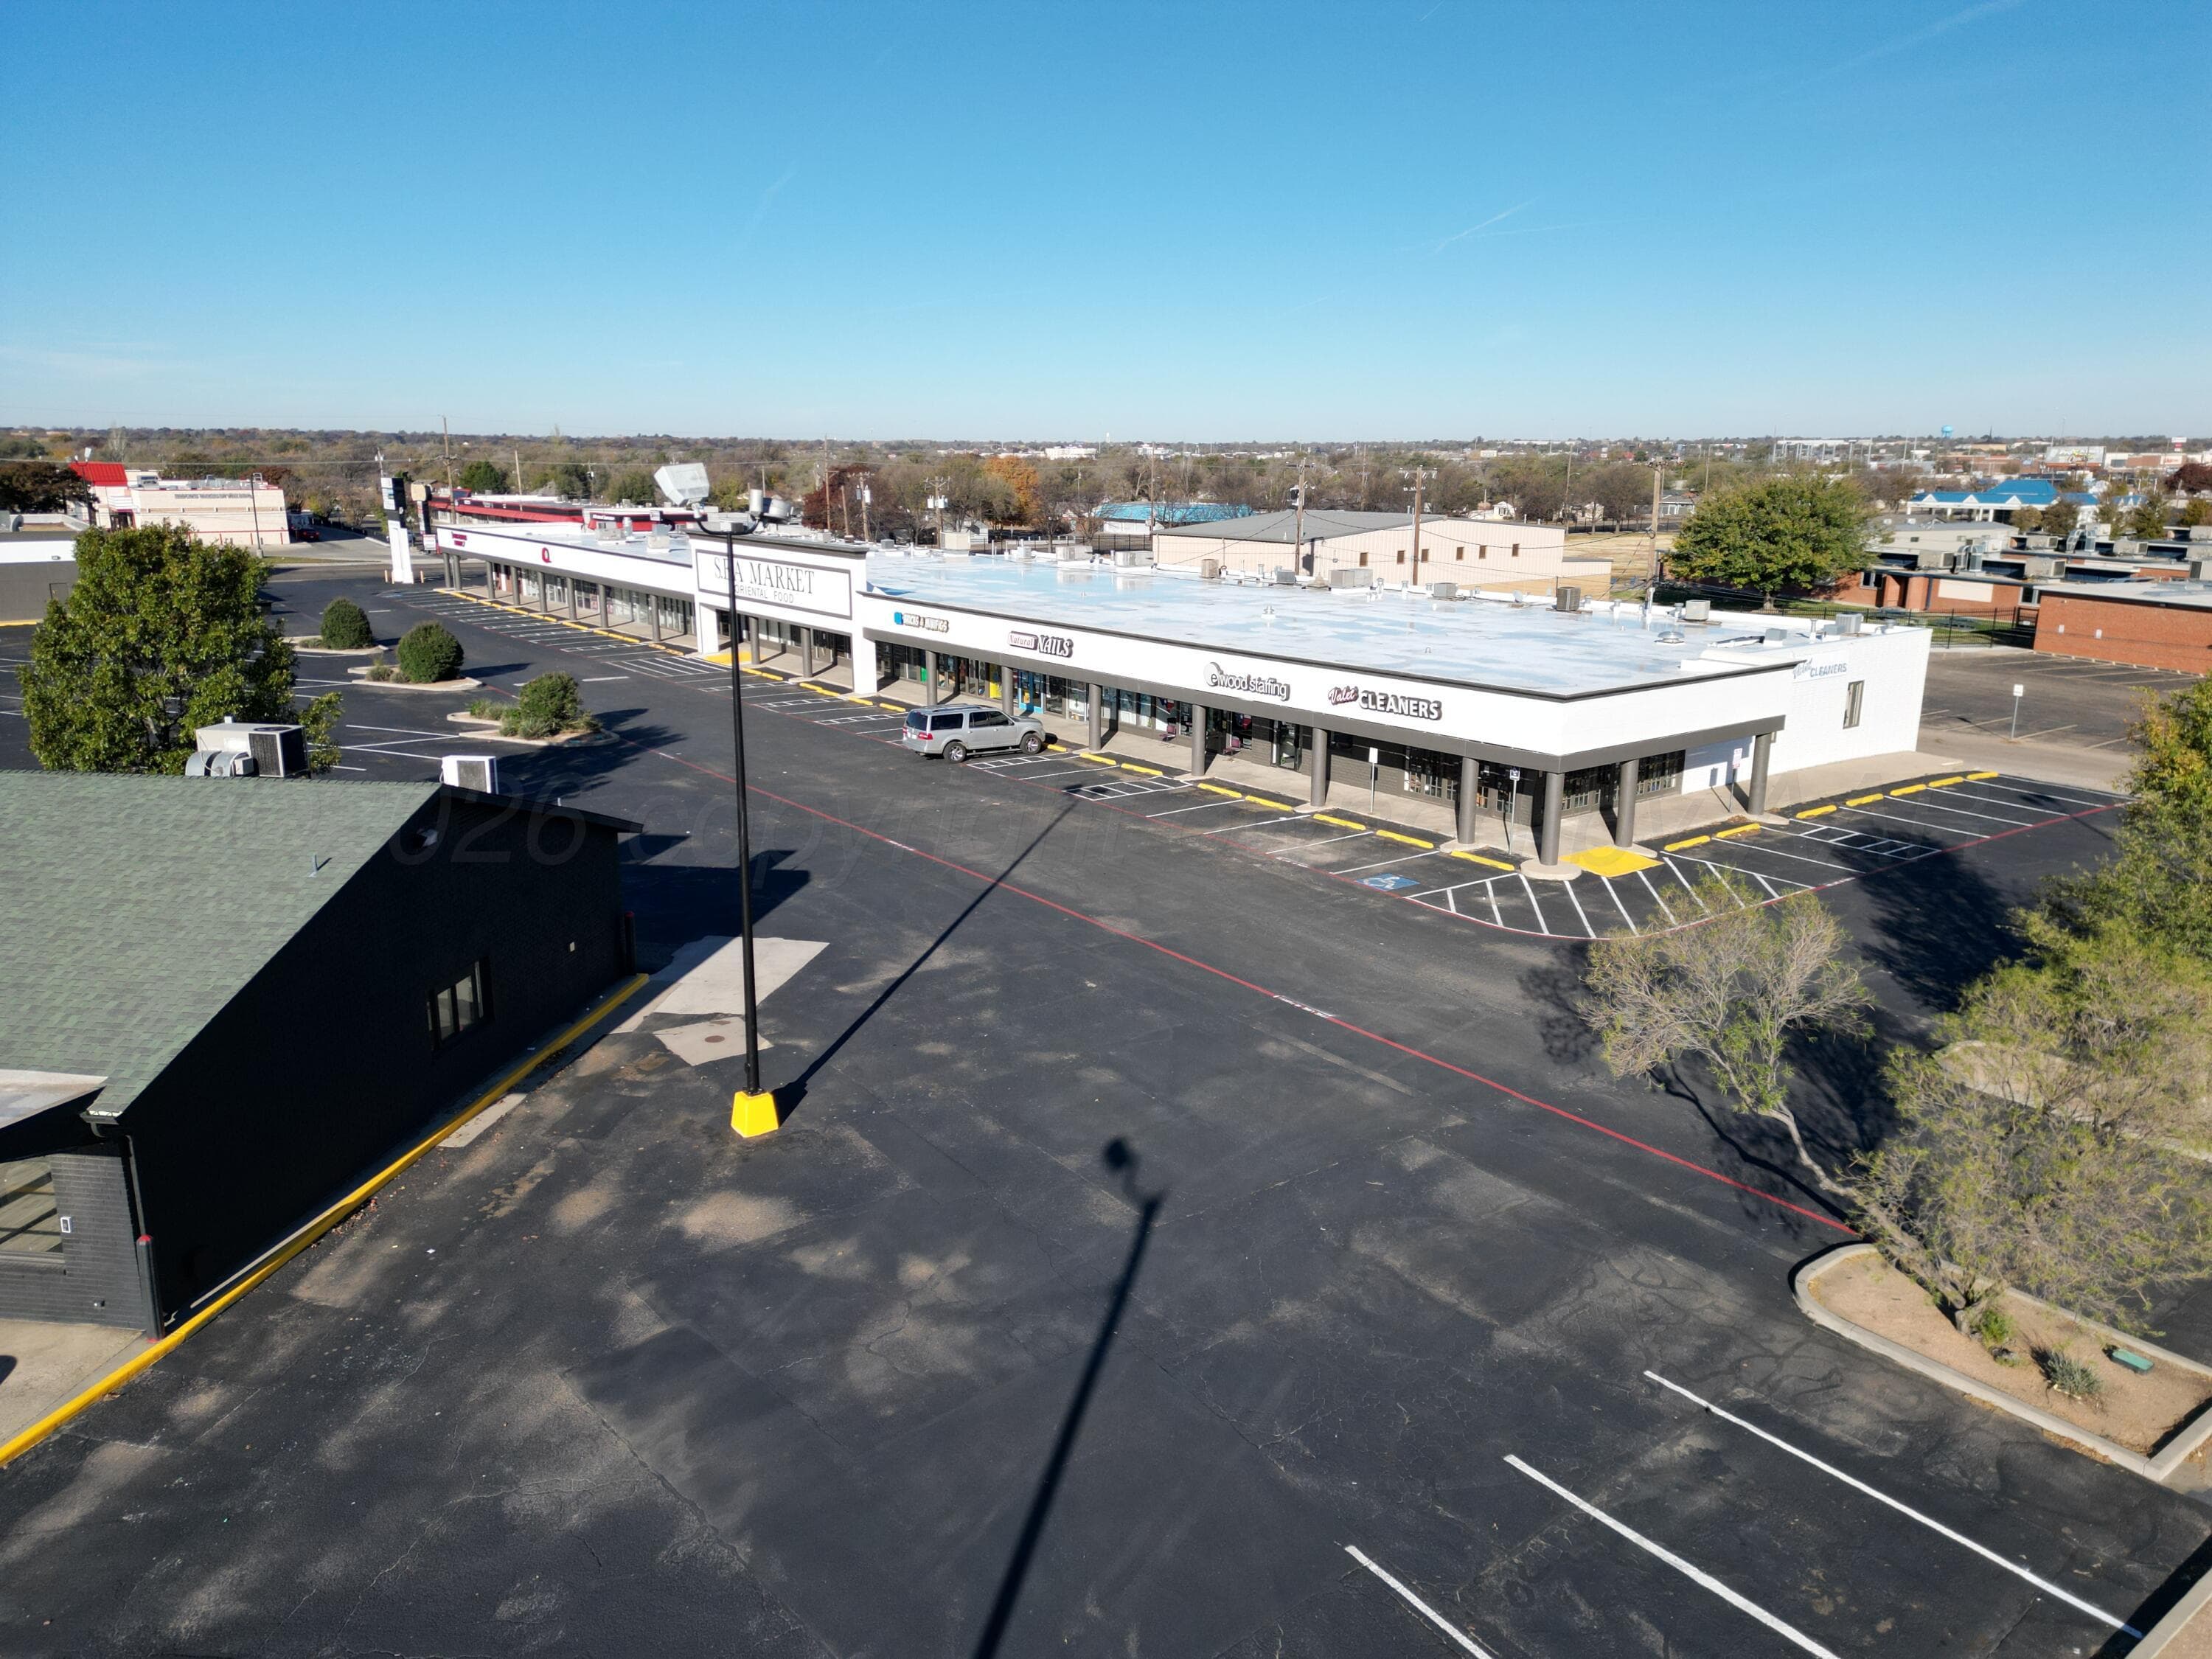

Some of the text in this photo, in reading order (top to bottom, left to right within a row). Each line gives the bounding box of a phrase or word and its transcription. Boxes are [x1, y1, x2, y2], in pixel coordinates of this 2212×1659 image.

[542, 547, 552, 563] Q
[749, 562, 815, 594] MARKET
[734, 585, 794, 604] ORIENTAL FOOD
[1009, 634, 1073, 658] Natural NAILS
[1810, 663, 1847, 678] CLEANERS
[1328, 686, 1442, 720] Valet CLEANERS
